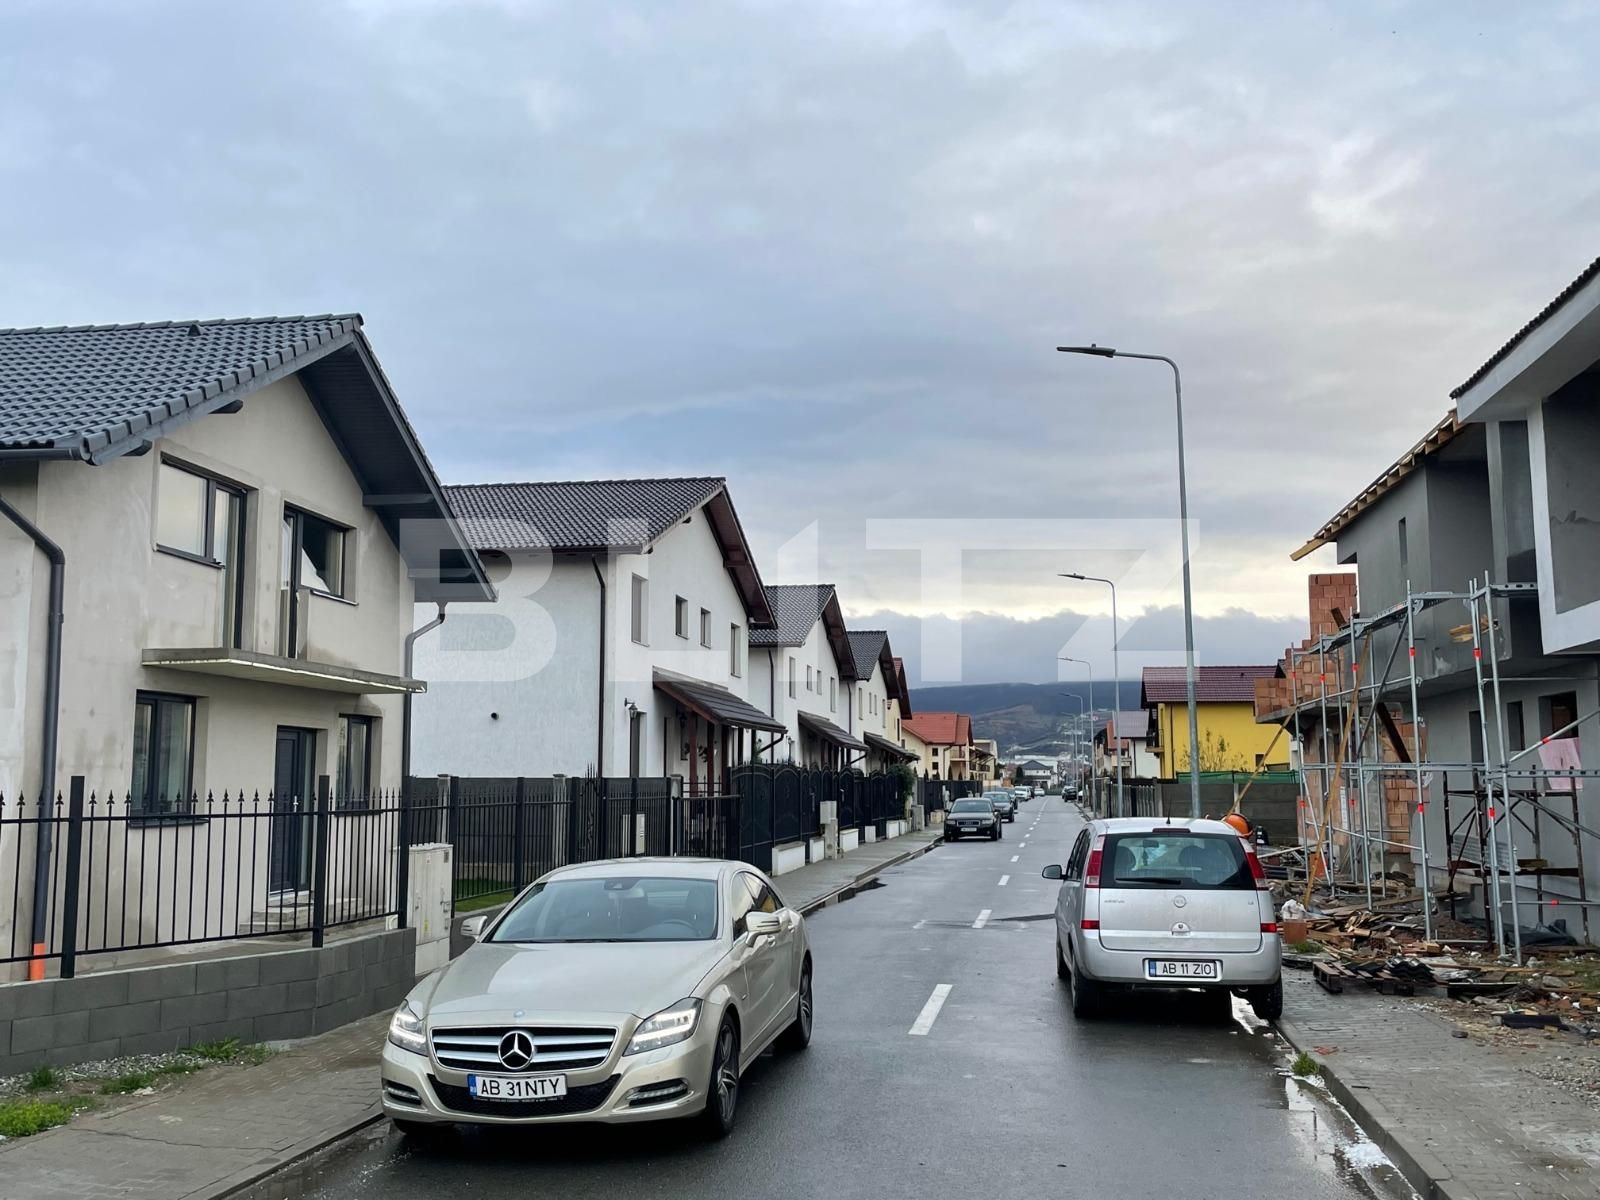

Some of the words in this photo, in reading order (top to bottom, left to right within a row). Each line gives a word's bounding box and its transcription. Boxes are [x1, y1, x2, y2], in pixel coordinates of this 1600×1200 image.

[1162, 963, 1177, 974] AB
[1181, 963, 1189, 975] 11
[1193, 963, 1212, 975] ZIO
[481, 1079, 501, 1096] AB
